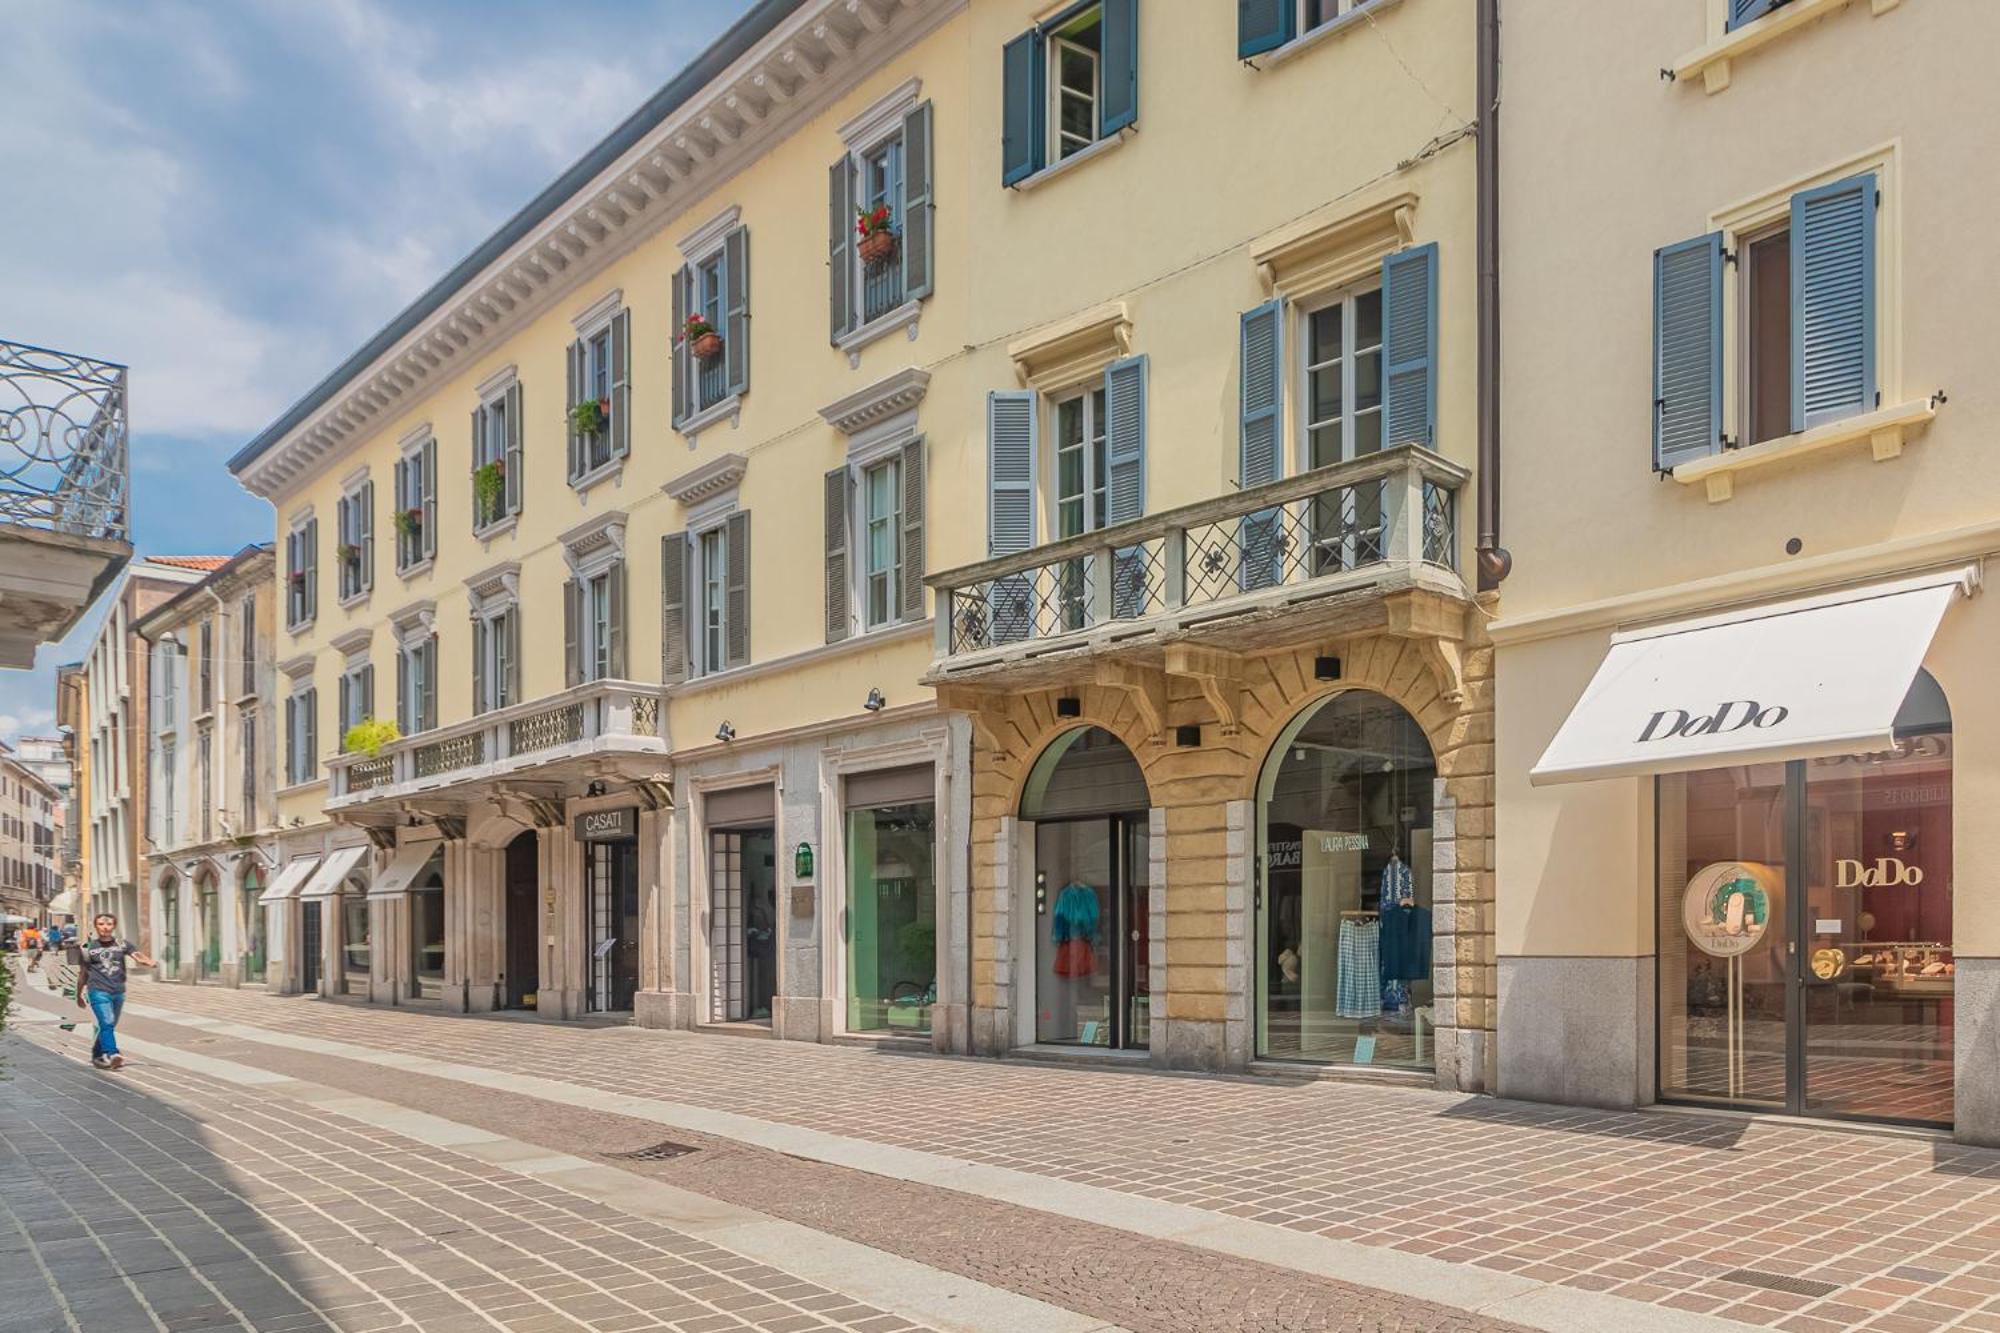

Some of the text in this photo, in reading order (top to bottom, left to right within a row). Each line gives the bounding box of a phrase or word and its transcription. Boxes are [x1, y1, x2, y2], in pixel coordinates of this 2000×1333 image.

[1633, 700, 1788, 743] DoDo
[586, 811, 621, 831] CASATI
[1320, 835, 1343, 853] LAURA
[1835, 857, 1924, 888] DoDo
